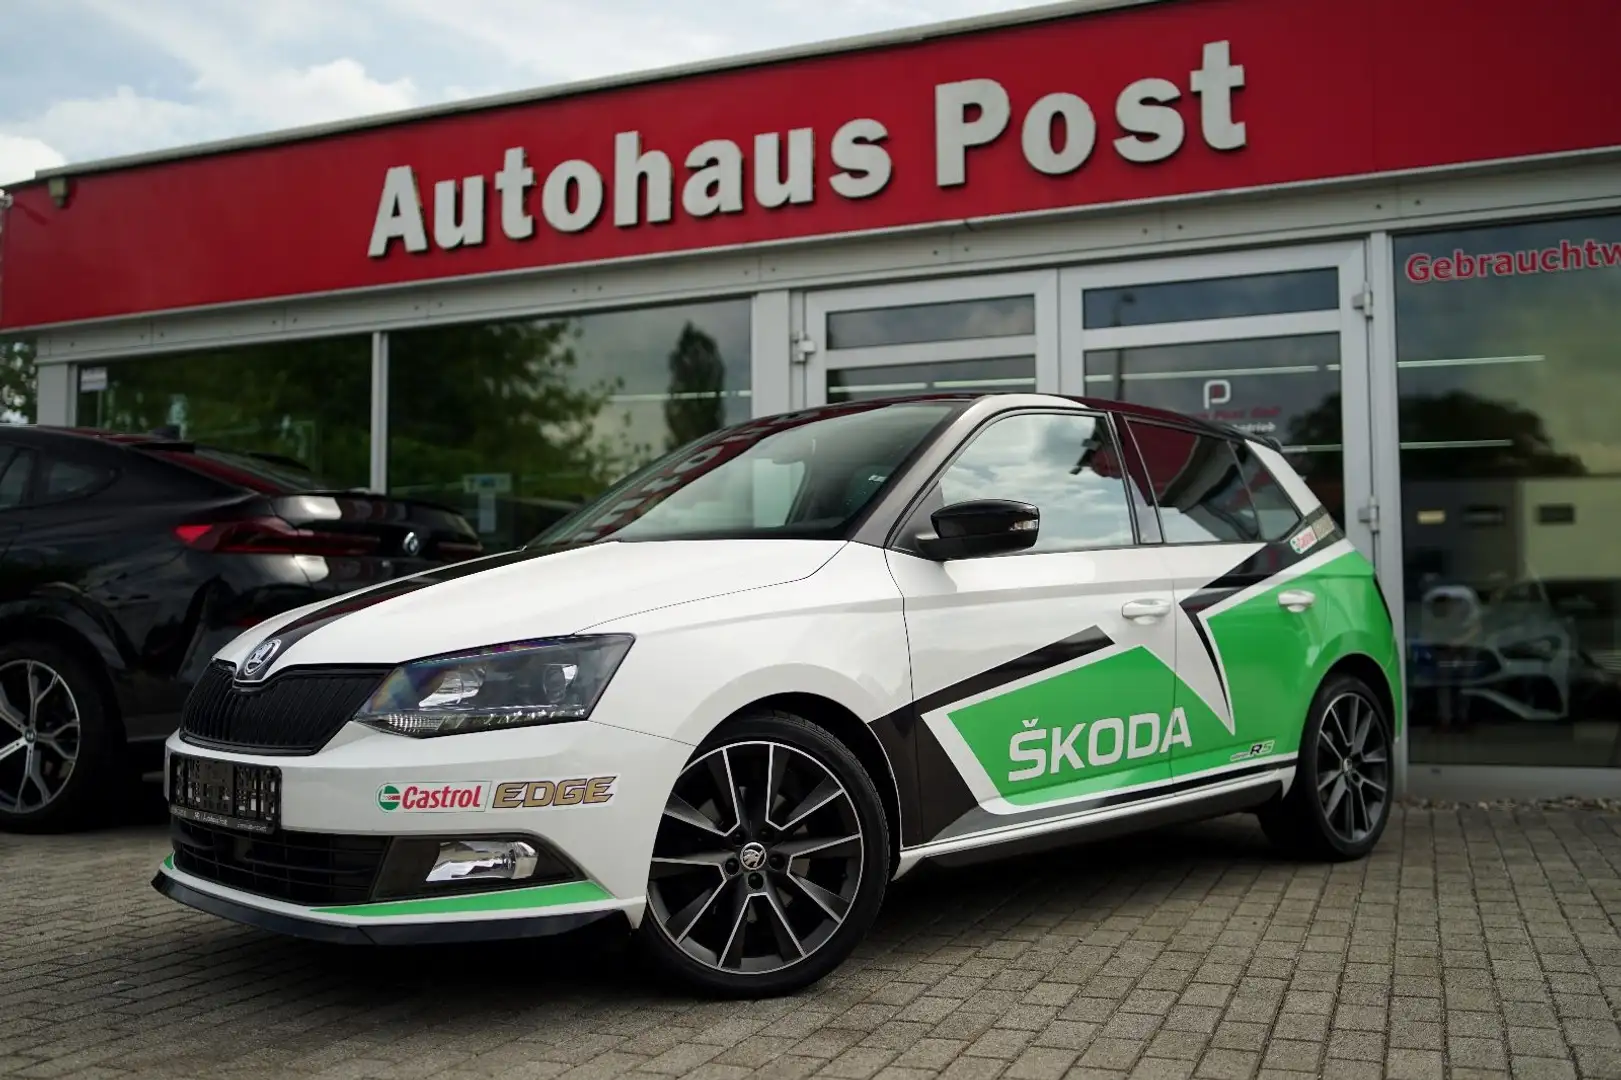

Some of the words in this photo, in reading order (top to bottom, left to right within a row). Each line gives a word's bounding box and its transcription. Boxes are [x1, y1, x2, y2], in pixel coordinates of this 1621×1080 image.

[367, 118, 893, 258] Autohaus
[935, 40, 1247, 187] Post
[1406, 239, 1621, 283] Gebrauchtw
[1008, 707, 1192, 782] ŠKODA
[402, 785, 482, 809] Castrol
[492, 775, 617, 808] EDGE
